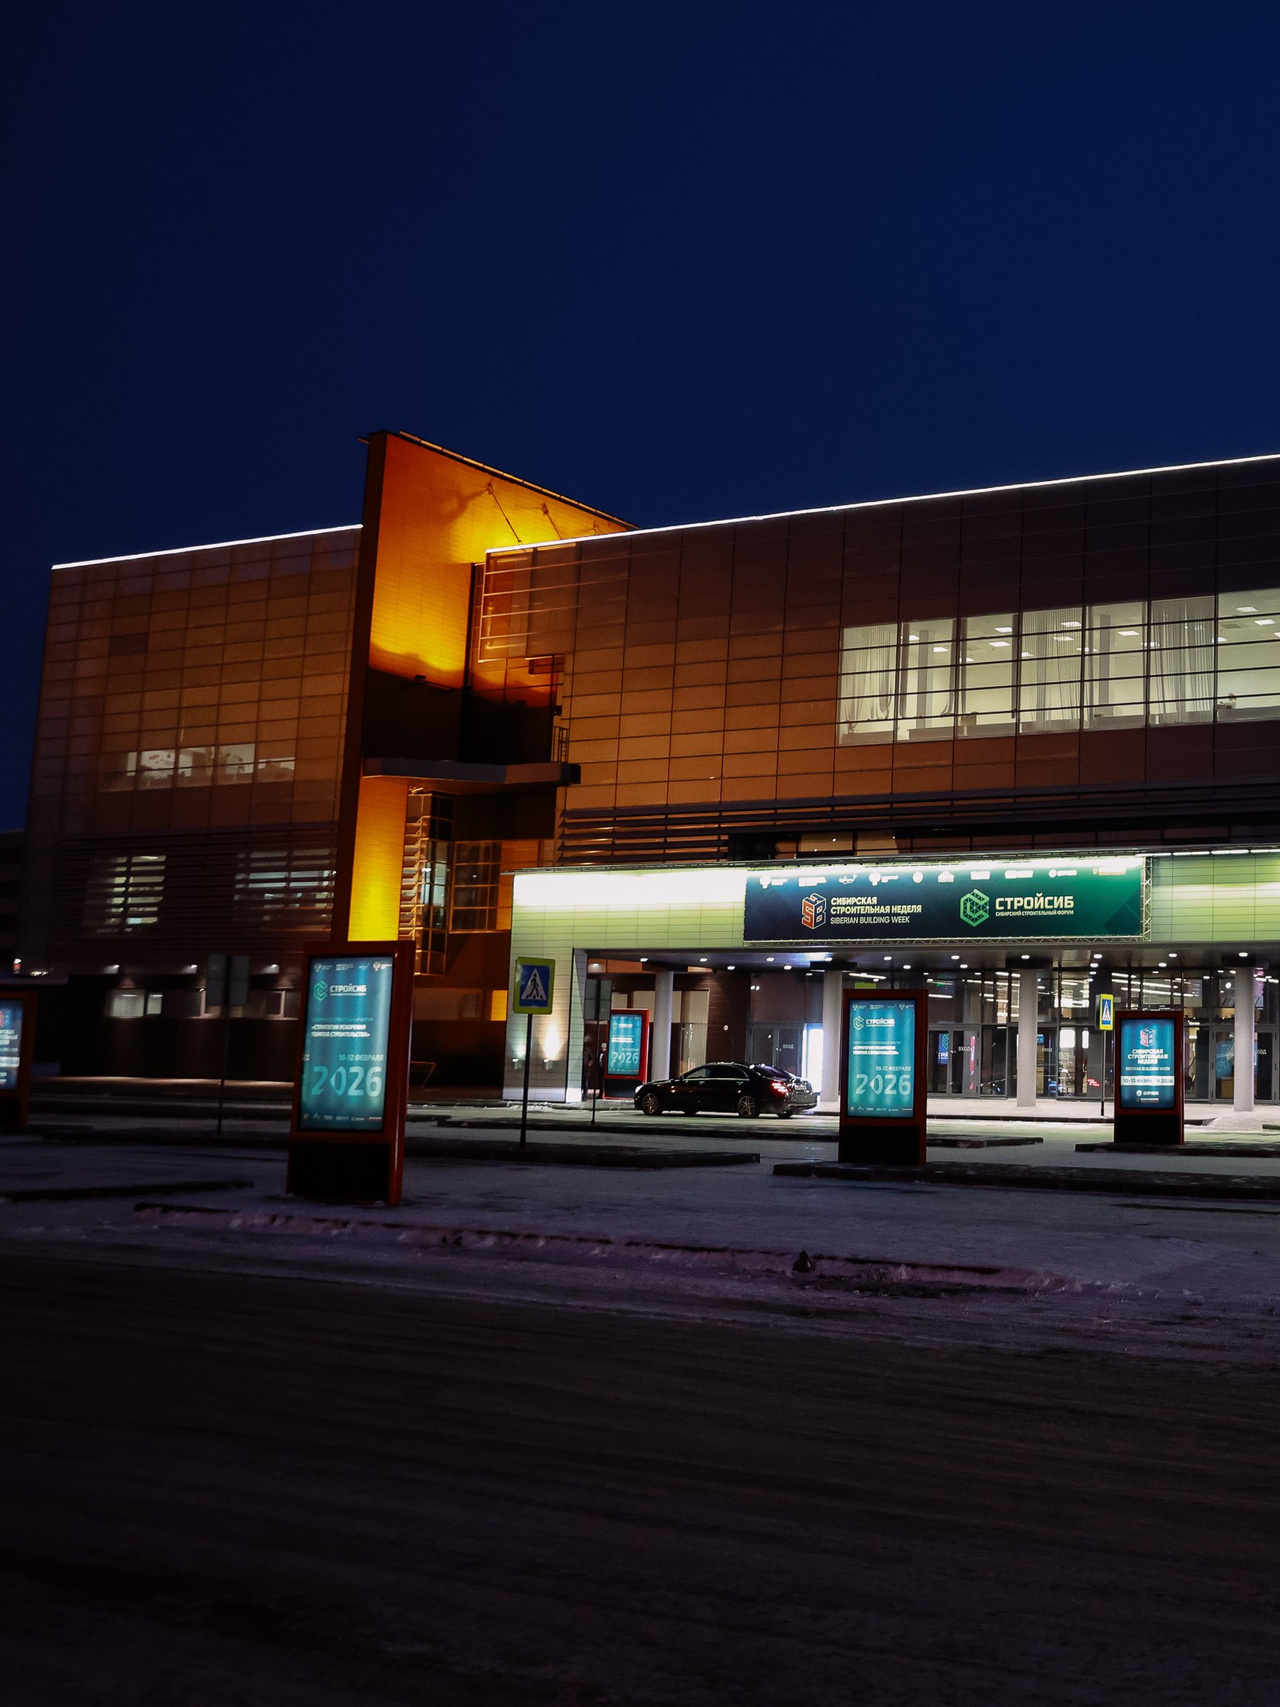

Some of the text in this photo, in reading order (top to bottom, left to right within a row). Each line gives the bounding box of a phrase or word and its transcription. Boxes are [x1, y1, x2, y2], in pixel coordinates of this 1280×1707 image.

[830, 896, 878, 906] СИБИРСКАЯ
[995, 892, 1075, 910] СТРОЙСИБ
[830, 904, 922, 915] СТРОИТЕЛЬНАЯ НЕДЕЛЯ
[830, 915, 911, 925] SIBERIAN BUILDING WEEK
[330, 983, 367, 992] СТРОЙСИБ
[611, 1051, 639, 1064] 2026
[311, 1065, 383, 1097] 2026
[855, 1074, 912, 1096] 2026
